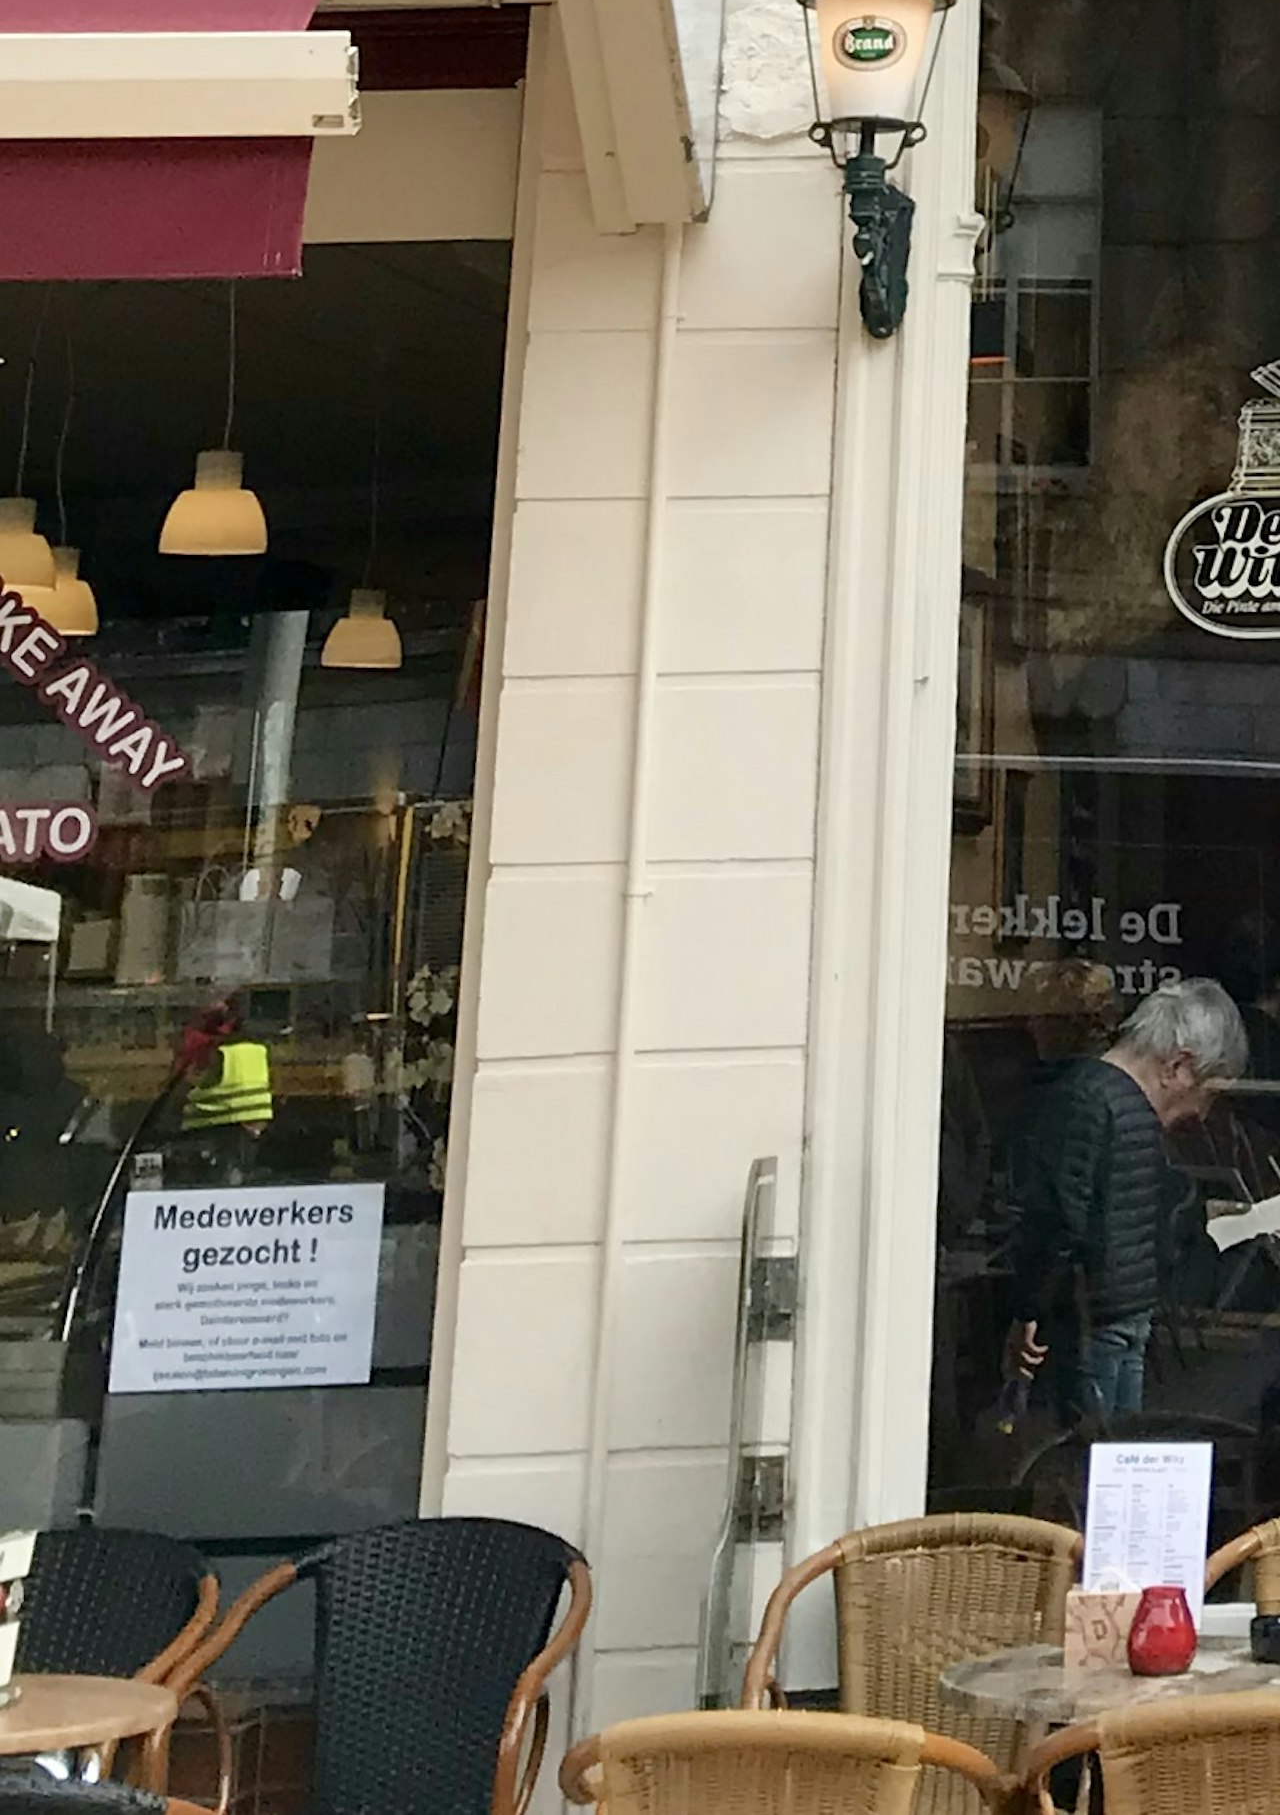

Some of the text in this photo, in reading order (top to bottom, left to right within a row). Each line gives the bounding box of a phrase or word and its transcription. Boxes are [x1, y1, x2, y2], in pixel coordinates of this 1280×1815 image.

[844, 31, 894, 54] Brand
[1202, 601, 1224, 615] Die
[46, 666, 185, 788] AWAY
[153, 1200, 354, 1230] Medewerkers
[182, 1238, 301, 1274] gezocht
